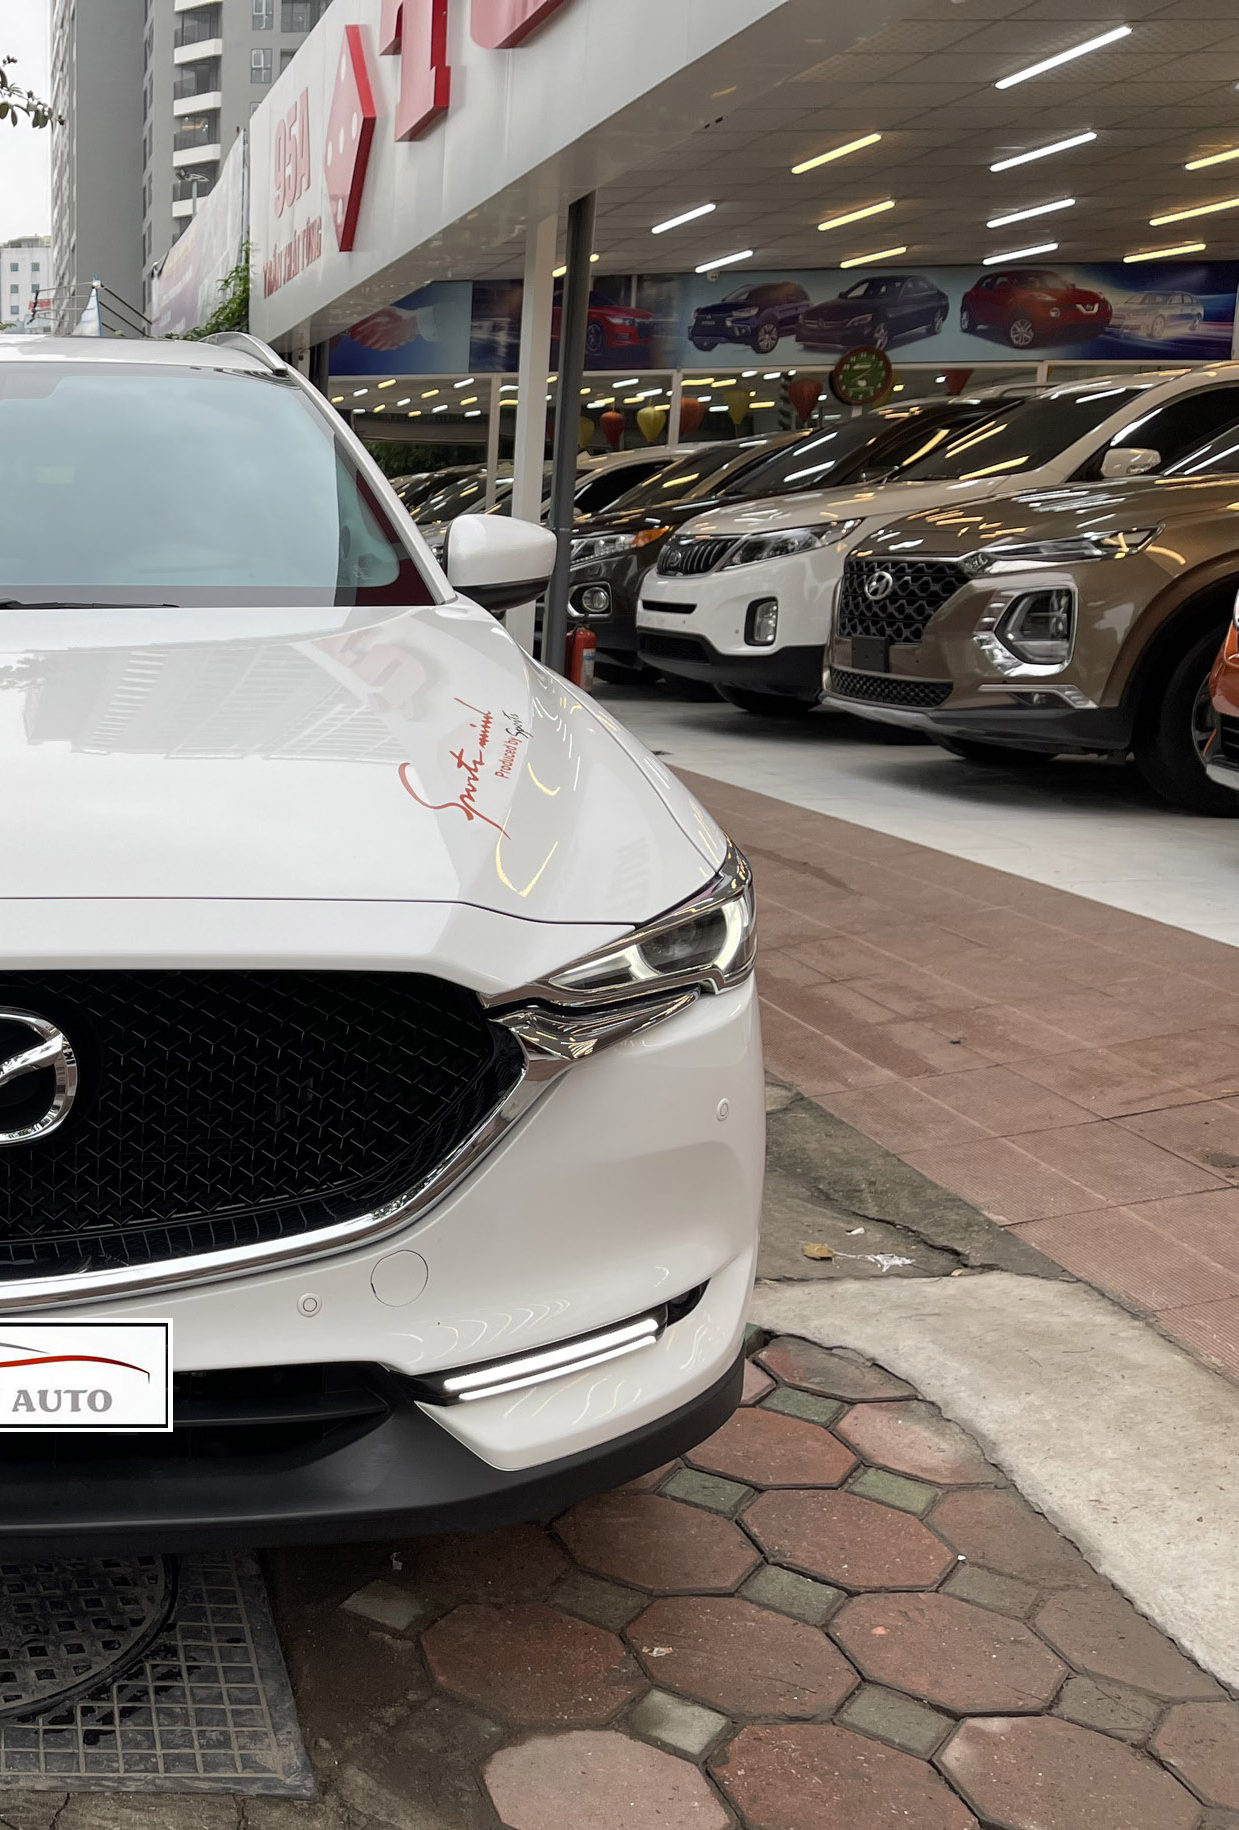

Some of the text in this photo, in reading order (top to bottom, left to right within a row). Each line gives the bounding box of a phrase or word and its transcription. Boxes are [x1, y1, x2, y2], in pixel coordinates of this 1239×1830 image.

[274, 87, 311, 219] 95A
[504, 736, 523, 748] by
[494, 743, 517, 779] Produced
